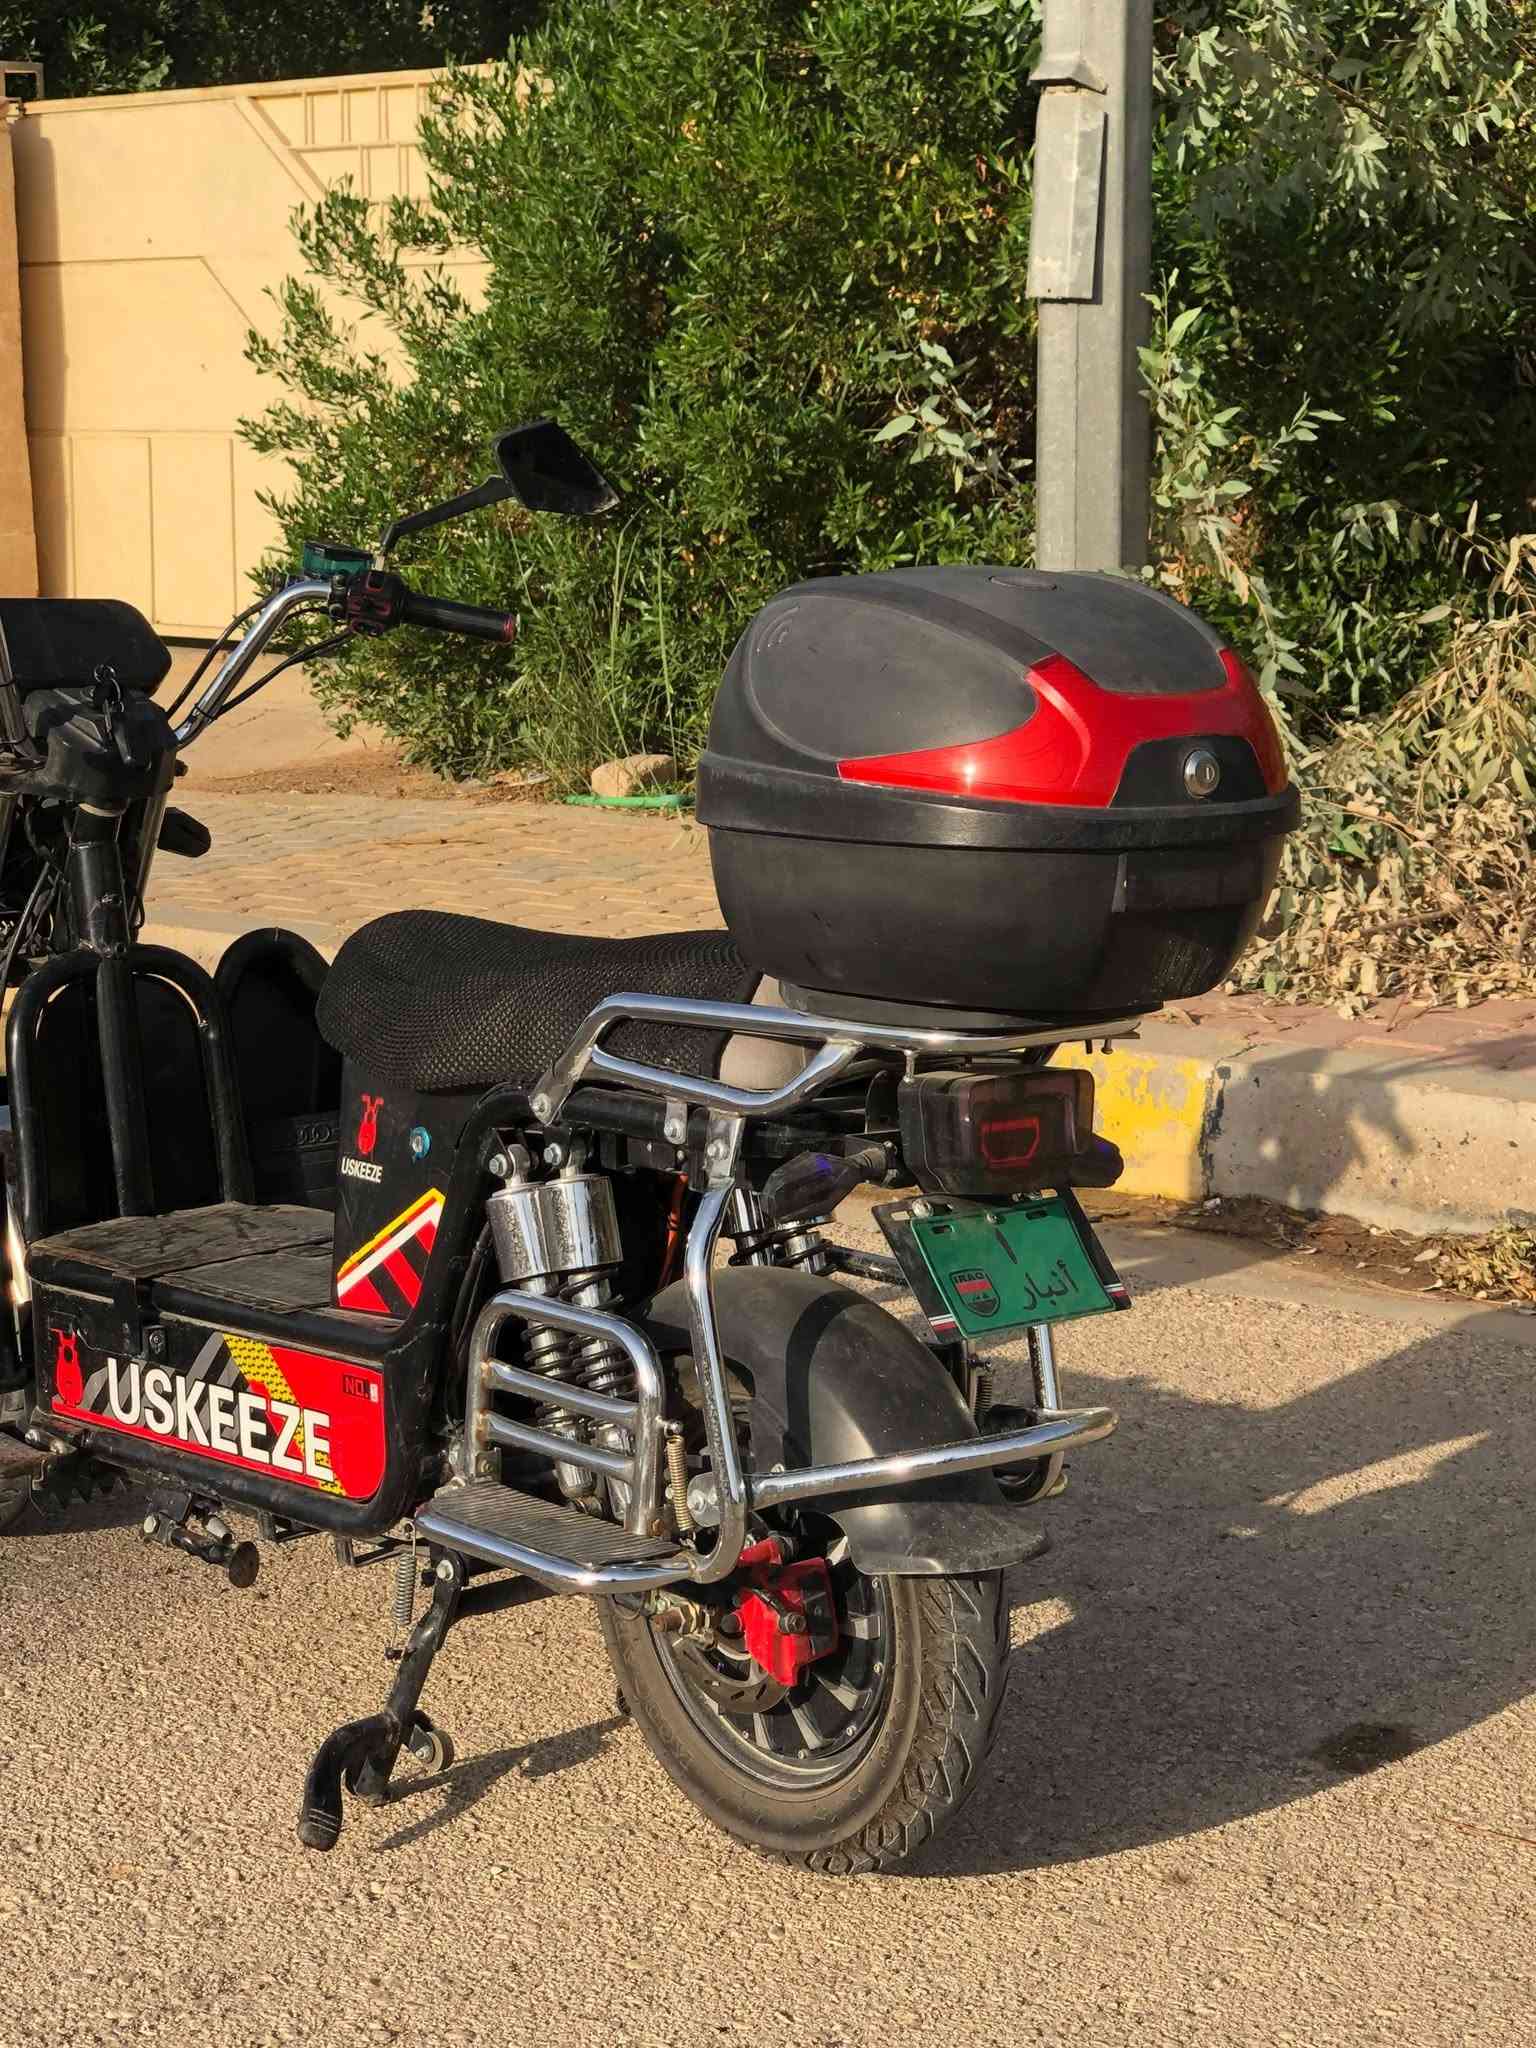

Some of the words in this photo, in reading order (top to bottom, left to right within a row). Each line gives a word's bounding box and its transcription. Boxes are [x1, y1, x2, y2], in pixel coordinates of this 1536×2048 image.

[341, 1156, 383, 1184] USKEEZE
[954, 1272, 985, 1283] IRAQ
[1023, 1259, 1079, 1310] أنبار
[107, 1357, 335, 1482] USKEEZE
